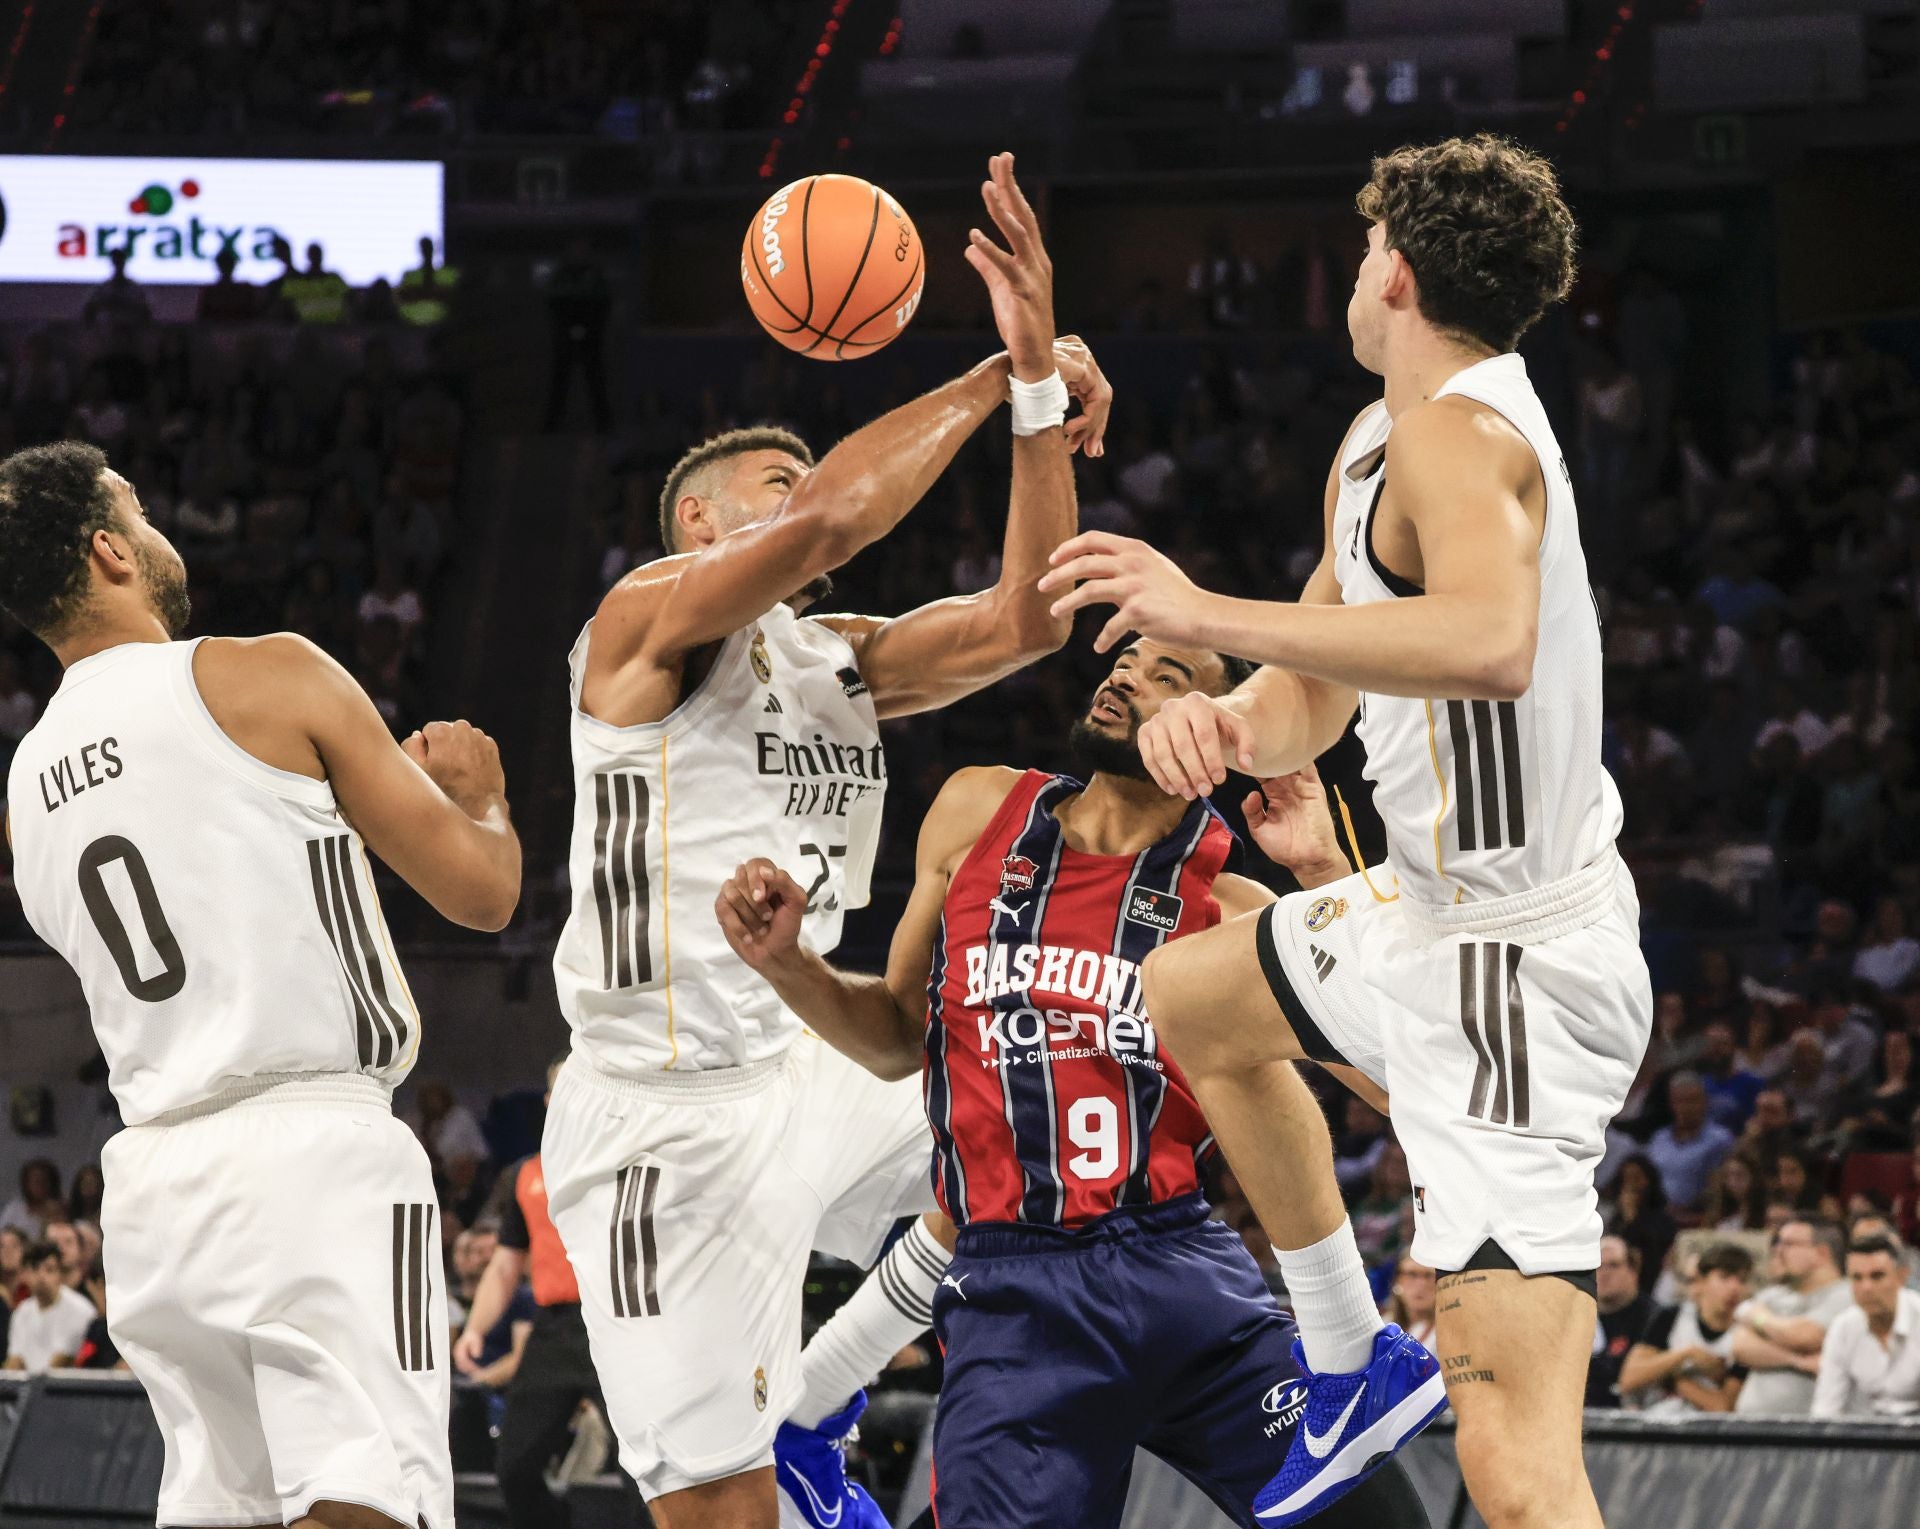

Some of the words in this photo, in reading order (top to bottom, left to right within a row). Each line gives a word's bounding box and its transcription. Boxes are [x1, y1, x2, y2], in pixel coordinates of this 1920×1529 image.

[57, 216, 280, 260] arratxa
[895, 223, 910, 262] acb
[39, 737, 123, 813] LYLES
[754, 731, 887, 780] Emirat
[785, 782, 820, 817] FLY
[823, 781, 878, 817] BET
[1003, 872, 1031, 886] BASKONIA
[78, 835, 186, 1002] 0
[1131, 909, 1175, 927] endesa
[1134, 897, 1154, 911] liga
[964, 943, 1152, 1023] BASKONI
[1026, 1046, 1108, 1064] Climatizac
[1067, 1096, 1120, 1180] 9
[1263, 1403, 1308, 1439] HYUN
